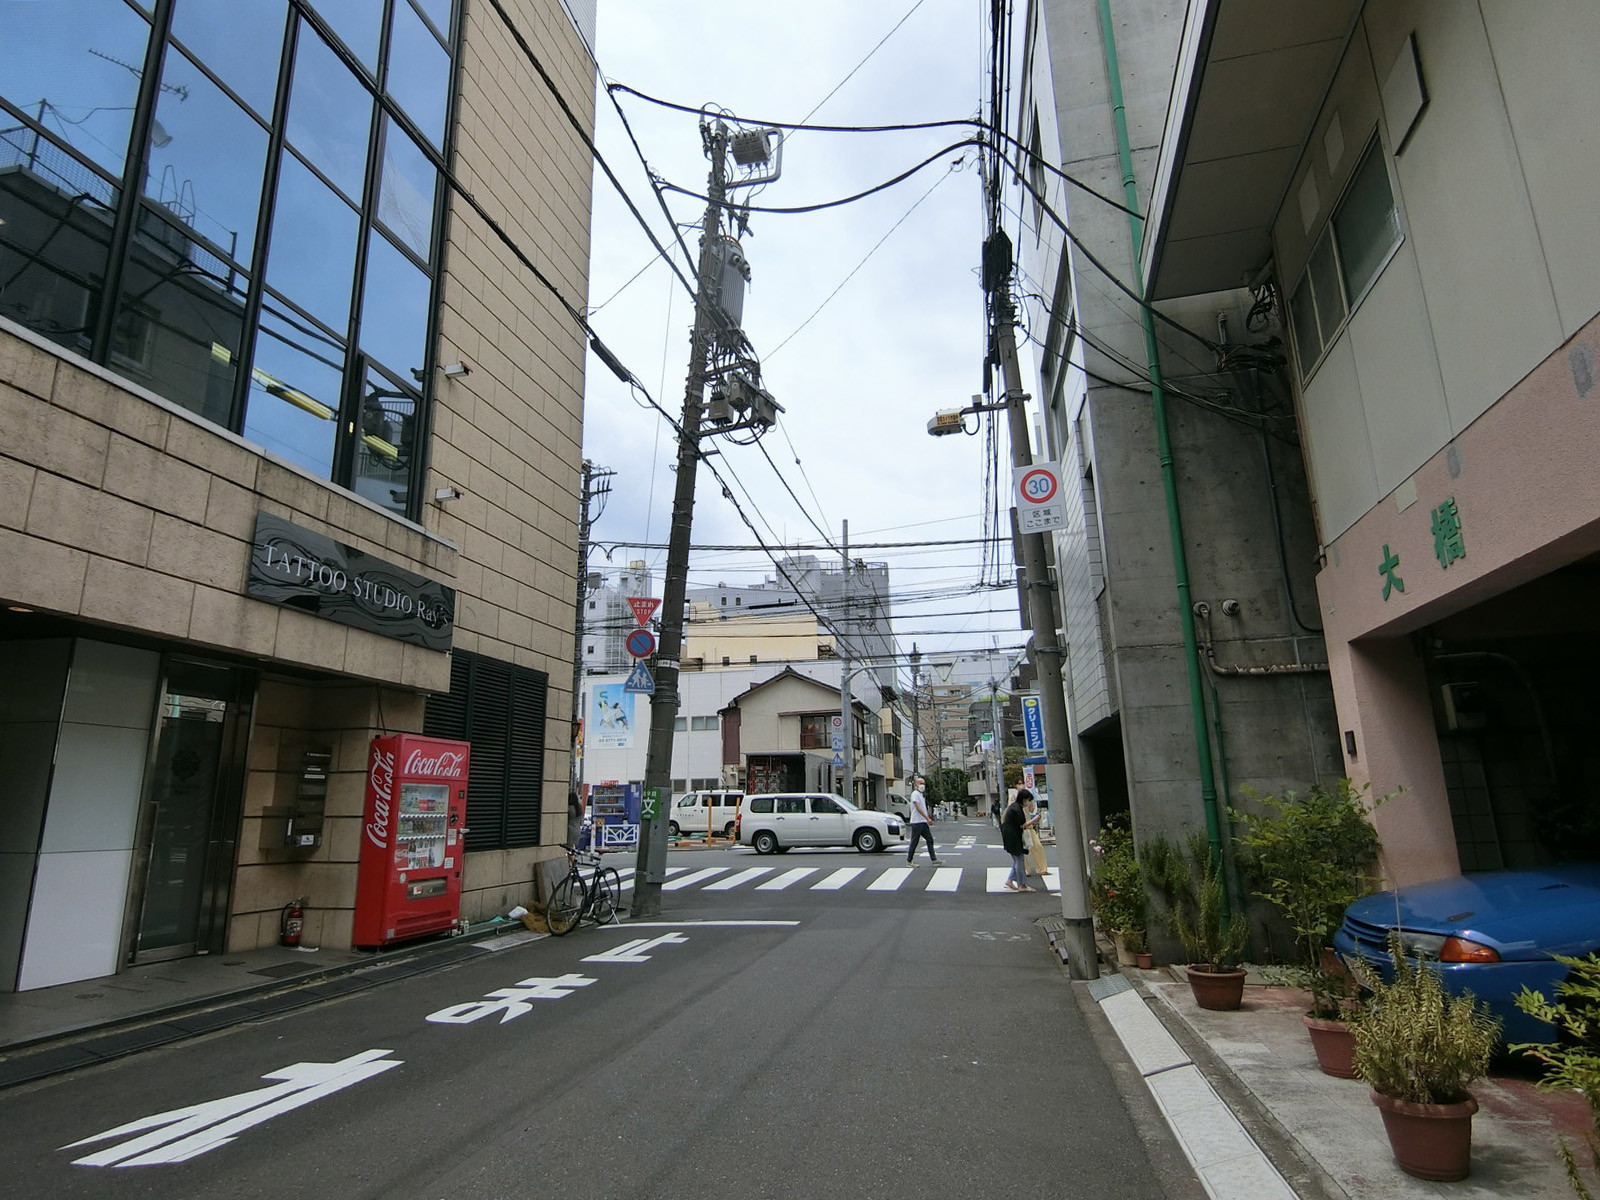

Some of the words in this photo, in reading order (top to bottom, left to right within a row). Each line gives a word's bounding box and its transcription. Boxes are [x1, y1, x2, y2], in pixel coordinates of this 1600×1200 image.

[1029, 479, 1049, 494] 30
[1026, 516, 1060, 527] ここまで
[1032, 509, 1051, 518] 区域
[1377, 496, 1466, 602] 大橋
[263, 544, 347, 591] TATTOO
[352, 576, 413, 614] STUDIO
[417, 600, 448, 628] Ray's
[1028, 707, 1041, 749] クリーニング
